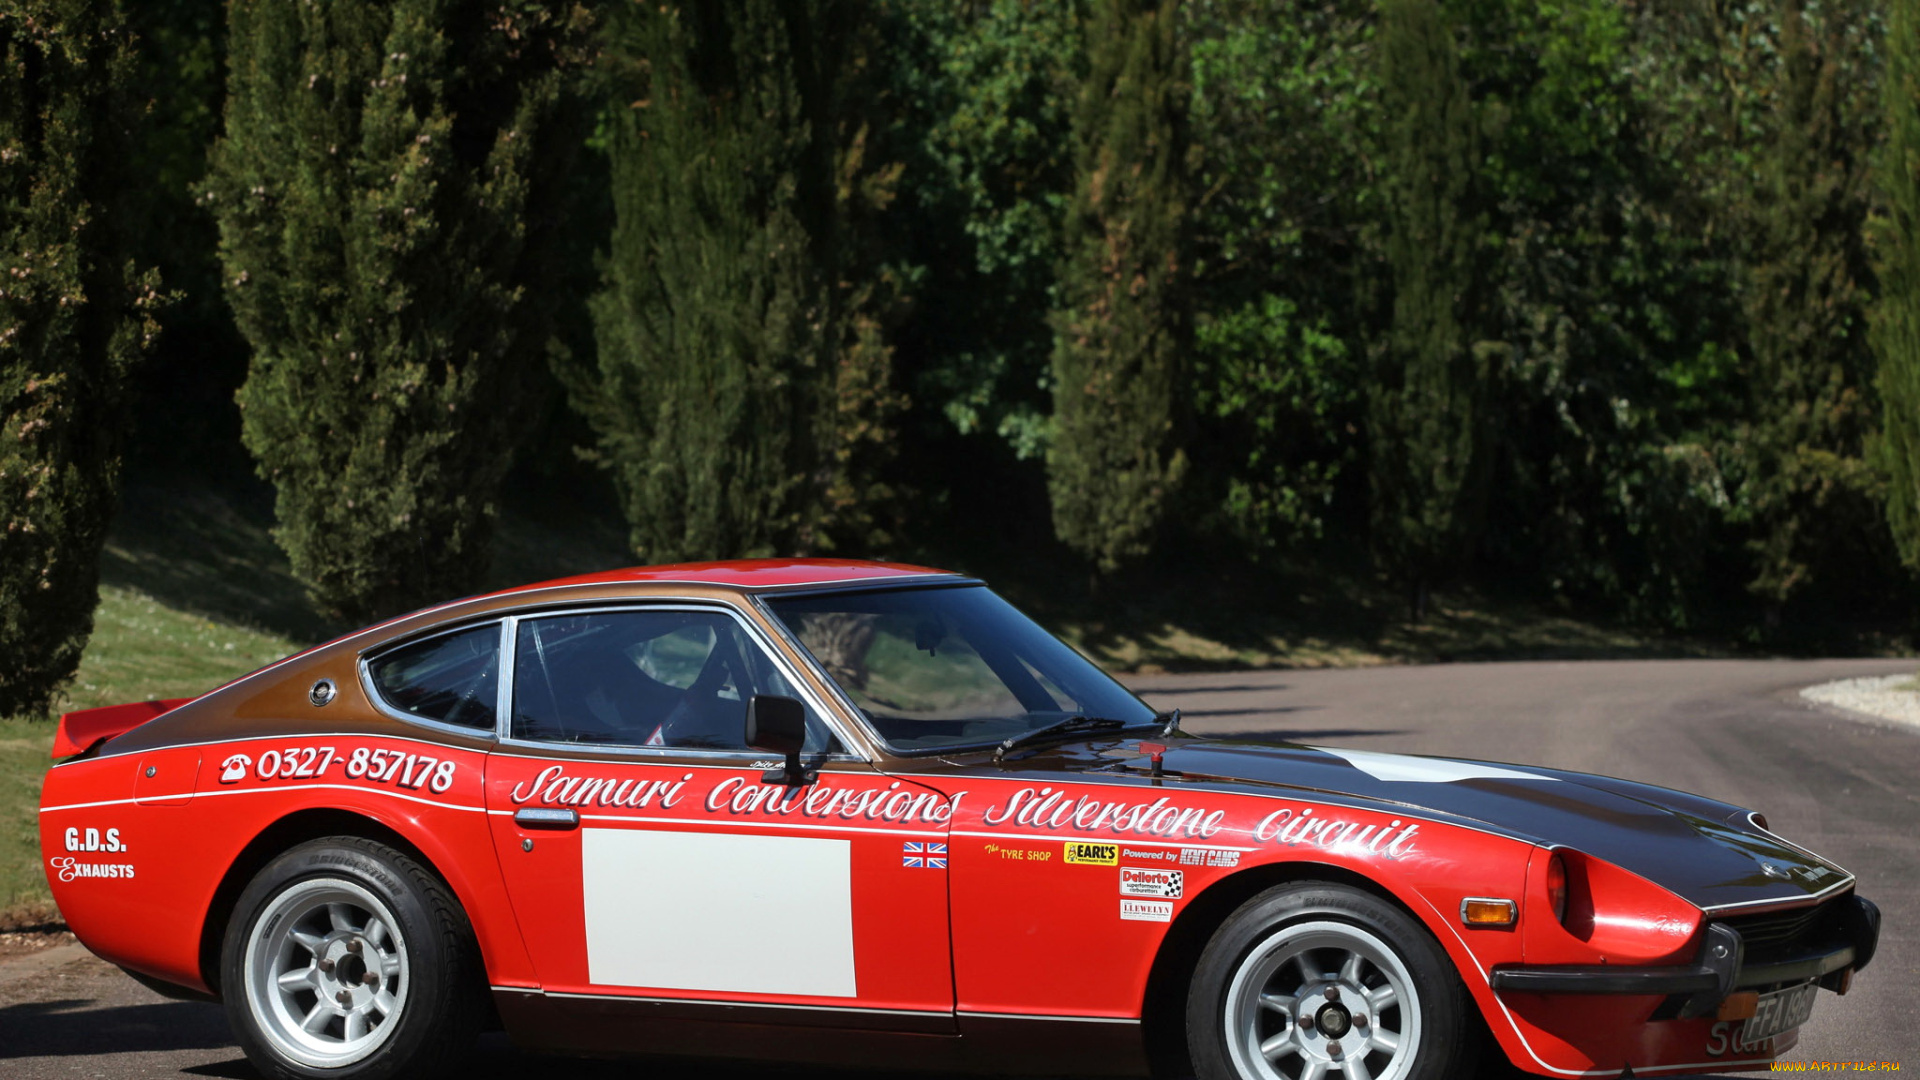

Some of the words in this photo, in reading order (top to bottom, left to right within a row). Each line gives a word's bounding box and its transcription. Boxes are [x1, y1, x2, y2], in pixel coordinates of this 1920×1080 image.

[509, 765, 694, 809] Samuri
[704, 775, 968, 829] Conversions
[982, 787, 1226, 840] Silverstone
[1252, 808, 1420, 860] Circuit
[65, 827, 127, 853] G.D.S.
[1001, 849, 1024, 860] TYRE
[1027, 850, 1052, 861] SHOP
[1077, 844, 1116, 859] EARL'S
[1122, 848, 1164, 860] Powered
[1165, 851, 1178, 862] by
[1179, 848, 1207, 865] KENT
[1206, 849, 1240, 867] CAMS
[1122, 870, 1170, 885] Dellorto
